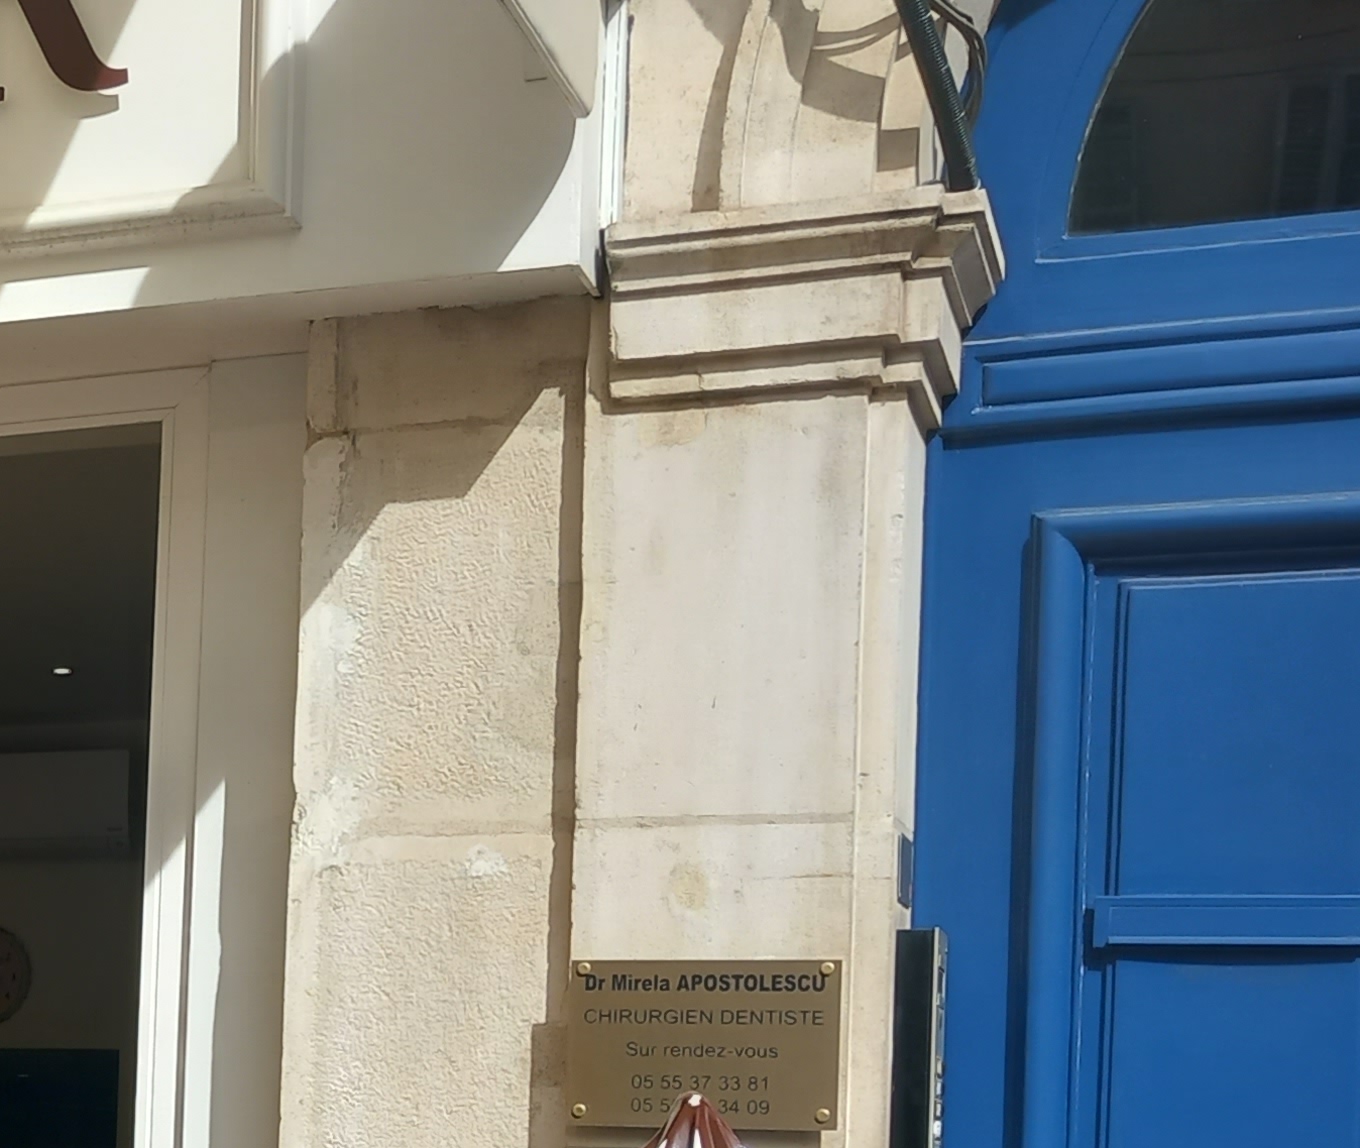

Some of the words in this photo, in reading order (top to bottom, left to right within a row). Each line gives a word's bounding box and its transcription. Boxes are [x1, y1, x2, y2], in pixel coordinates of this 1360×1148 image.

[585, 974, 605, 991] Dr
[611, 973, 670, 992] Mirela
[676, 974, 826, 993] APOSTOLESCU
[583, 1008, 713, 1025] CHIRURGIEN
[720, 1009, 825, 1026] DENTISTE
[625, 1041, 657, 1058] Sur
[664, 1042, 779, 1059] rendez-vous
[631, 1074, 654, 1090] 05
[660, 1074, 683, 1090] 55
[689, 1075, 711, 1091] 37
[718, 1076, 741, 1091] 33
[747, 1076, 769, 1092] 81
[631, 1097, 653, 1113] 05
[660, 1098, 676, 1113] 5
[718, 1099, 740, 1114] 34
[747, 1099, 770, 1115] 09
